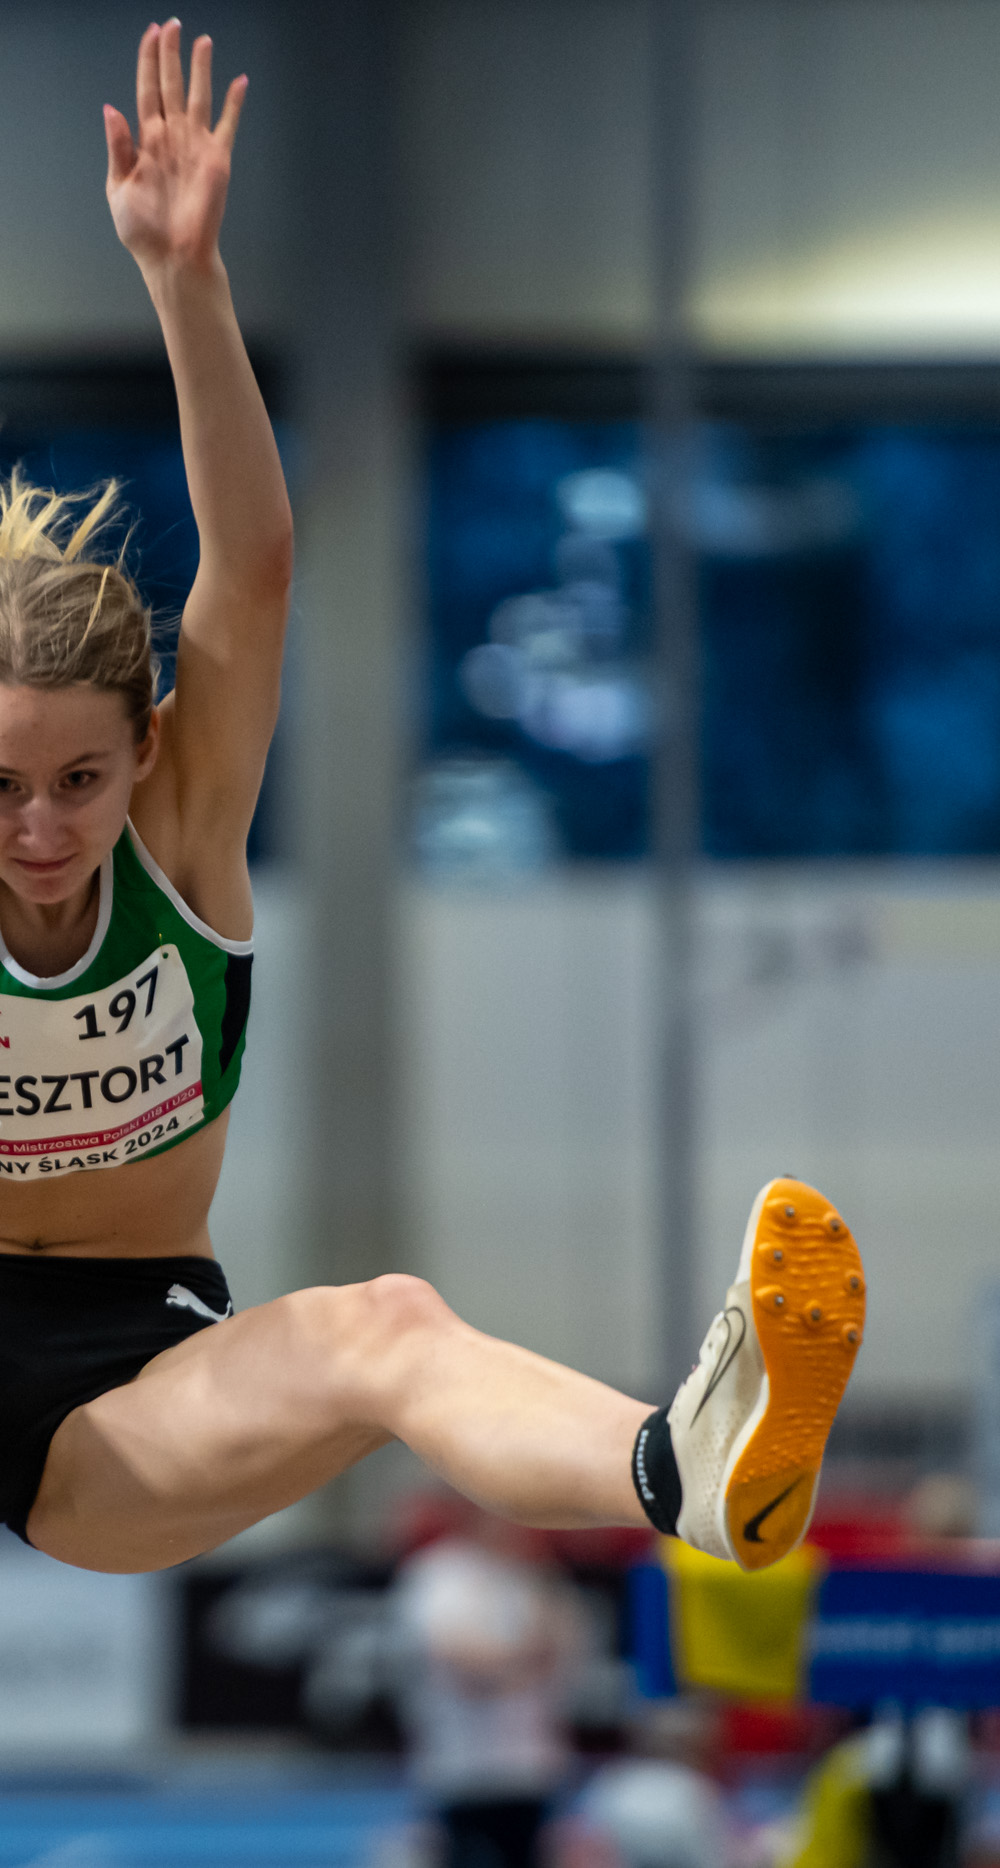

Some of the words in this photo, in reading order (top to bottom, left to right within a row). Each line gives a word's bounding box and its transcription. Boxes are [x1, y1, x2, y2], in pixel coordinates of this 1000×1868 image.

[73, 965, 158, 1040] 197
[13, 1136, 99, 1153] Mistrzostwa
[103, 1119, 139, 1142] Polski
[142, 1106, 163, 1123] U18
[172, 1087, 196, 1106] U20
[38, 1147, 119, 1173] ŚLĄSK
[124, 1116, 180, 1156] 2024
